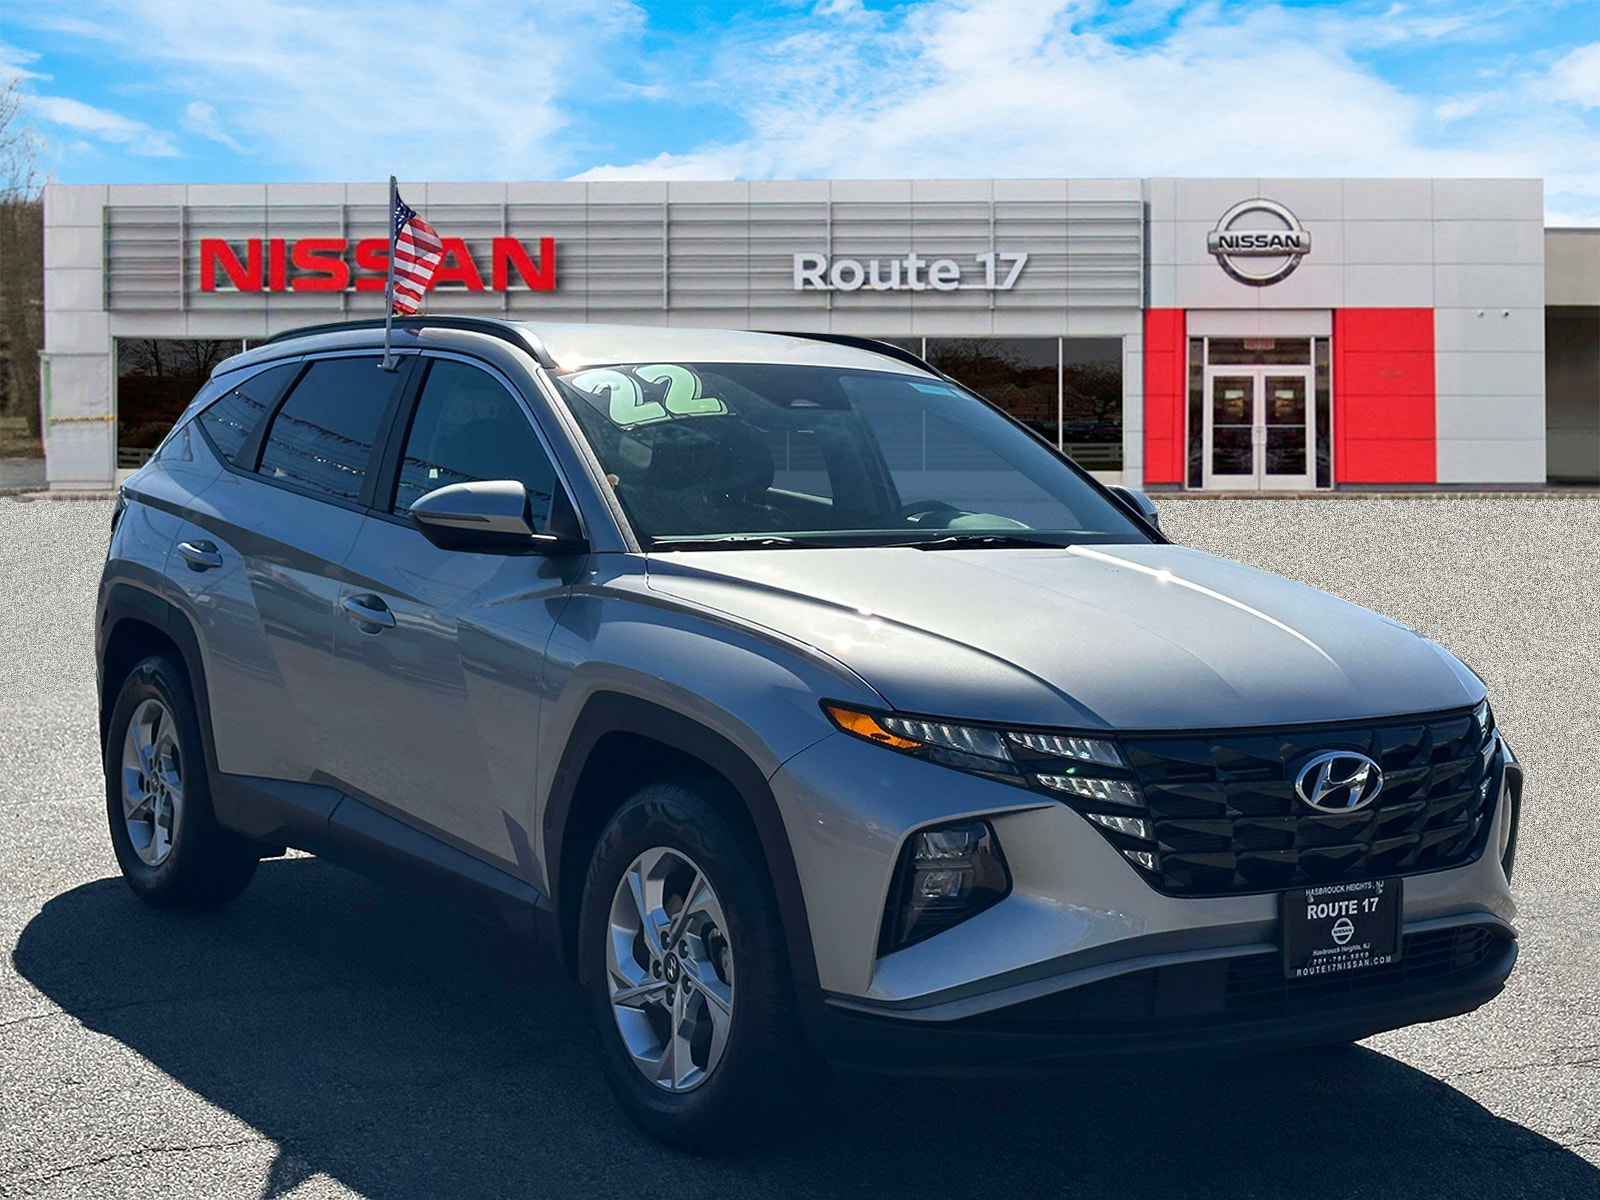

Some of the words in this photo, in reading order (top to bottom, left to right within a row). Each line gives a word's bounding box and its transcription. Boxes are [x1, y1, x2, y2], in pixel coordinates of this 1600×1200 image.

[1219, 235, 1300, 248] NISSAN
[793, 252, 961, 291] Route
[975, 252, 1028, 290] 17
[571, 364, 729, 426] 22
[1305, 885, 1345, 897] HASBROUCK
[1307, 900, 1358, 919] ROUTE
[1362, 897, 1379, 913] 17
[1296, 956, 1392, 977] ROUTE17NISSAN.COM
